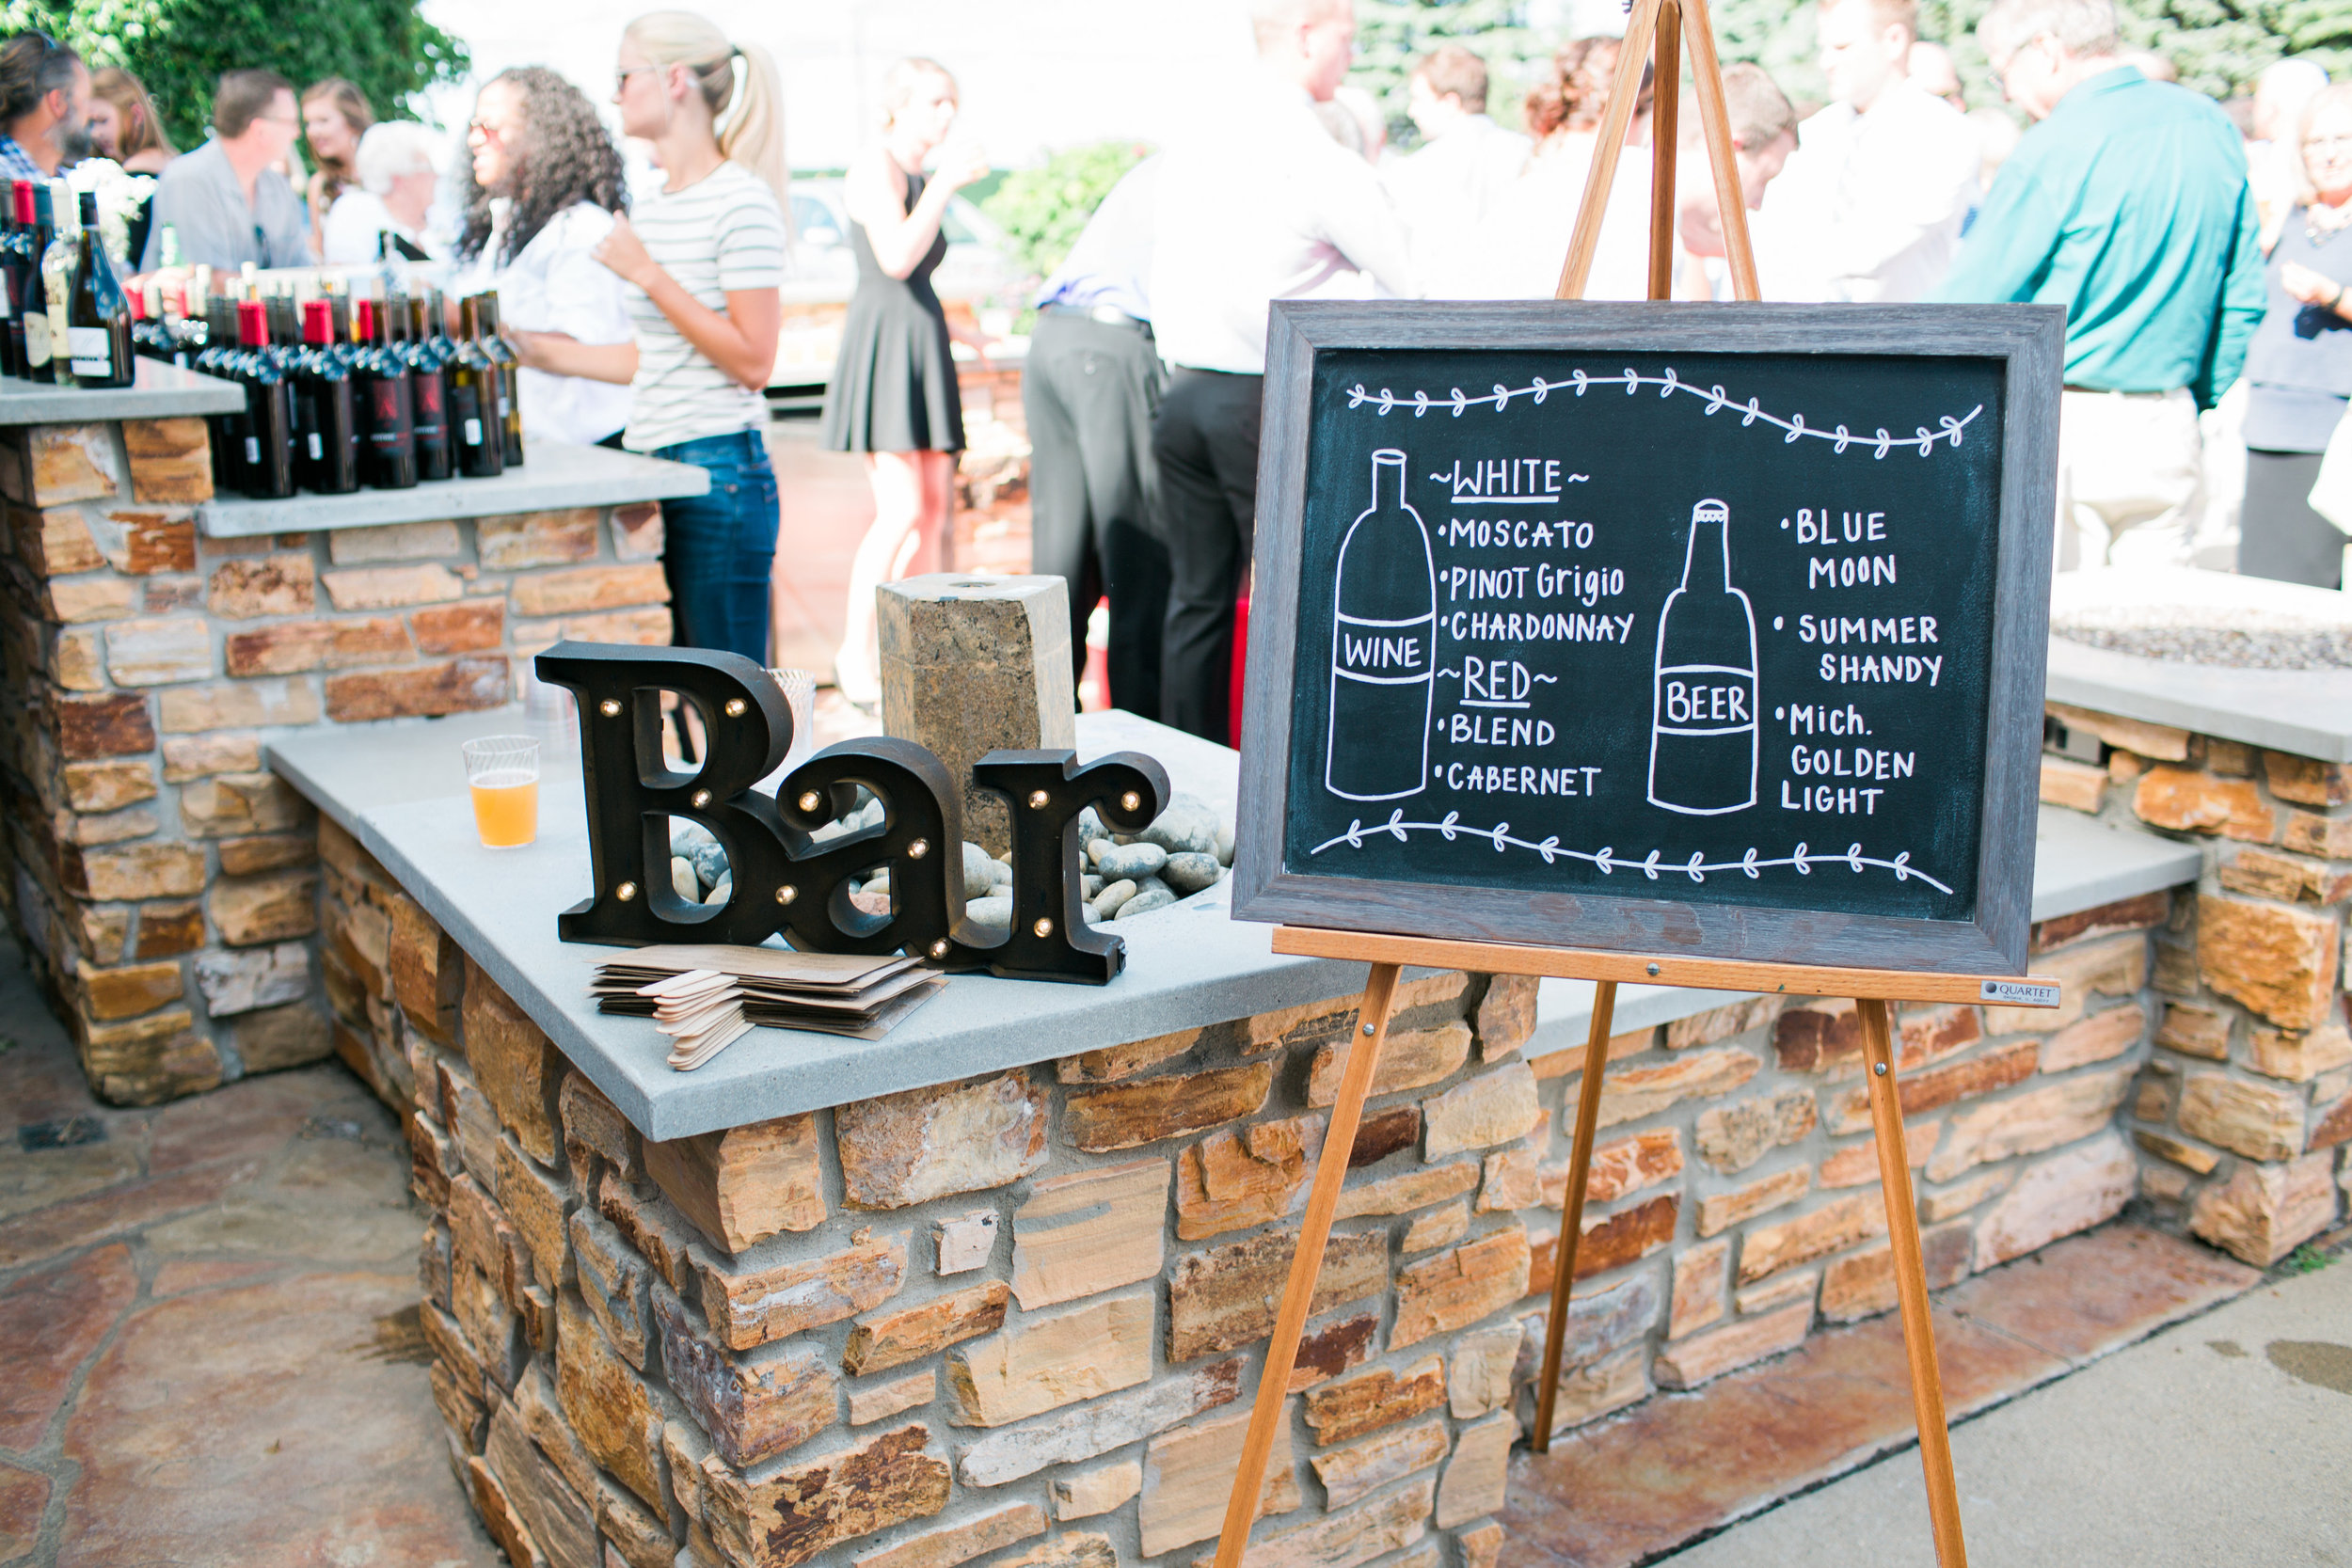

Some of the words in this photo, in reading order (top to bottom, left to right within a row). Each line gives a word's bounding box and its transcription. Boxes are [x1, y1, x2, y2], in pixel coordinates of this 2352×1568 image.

[1450, 517, 1594, 549] MOSCATO
[1797, 508, 1887, 546] BLUE
[1450, 566, 1531, 602] PINOT
[1536, 562, 1625, 608] Grigio
[1808, 554, 1897, 590] MOON
[1451, 611, 1635, 644] CHARDONNAY
[1798, 614, 1938, 645] SUMMER
[1344, 634, 1422, 669] WINE
[1463, 655, 1531, 701] RED
[1819, 653, 1943, 687] SHANDY
[1666, 681, 1751, 724] BEER
[1451, 713, 1555, 747] BLEND
[1447, 762, 1602, 797] CABERNET
[1791, 744, 1915, 781] GOLDEN
[534, 640, 1171, 986] Bar
[1781, 780, 1884, 816] LIGHT
[1999, 984, 2052, 998] QUARTET
